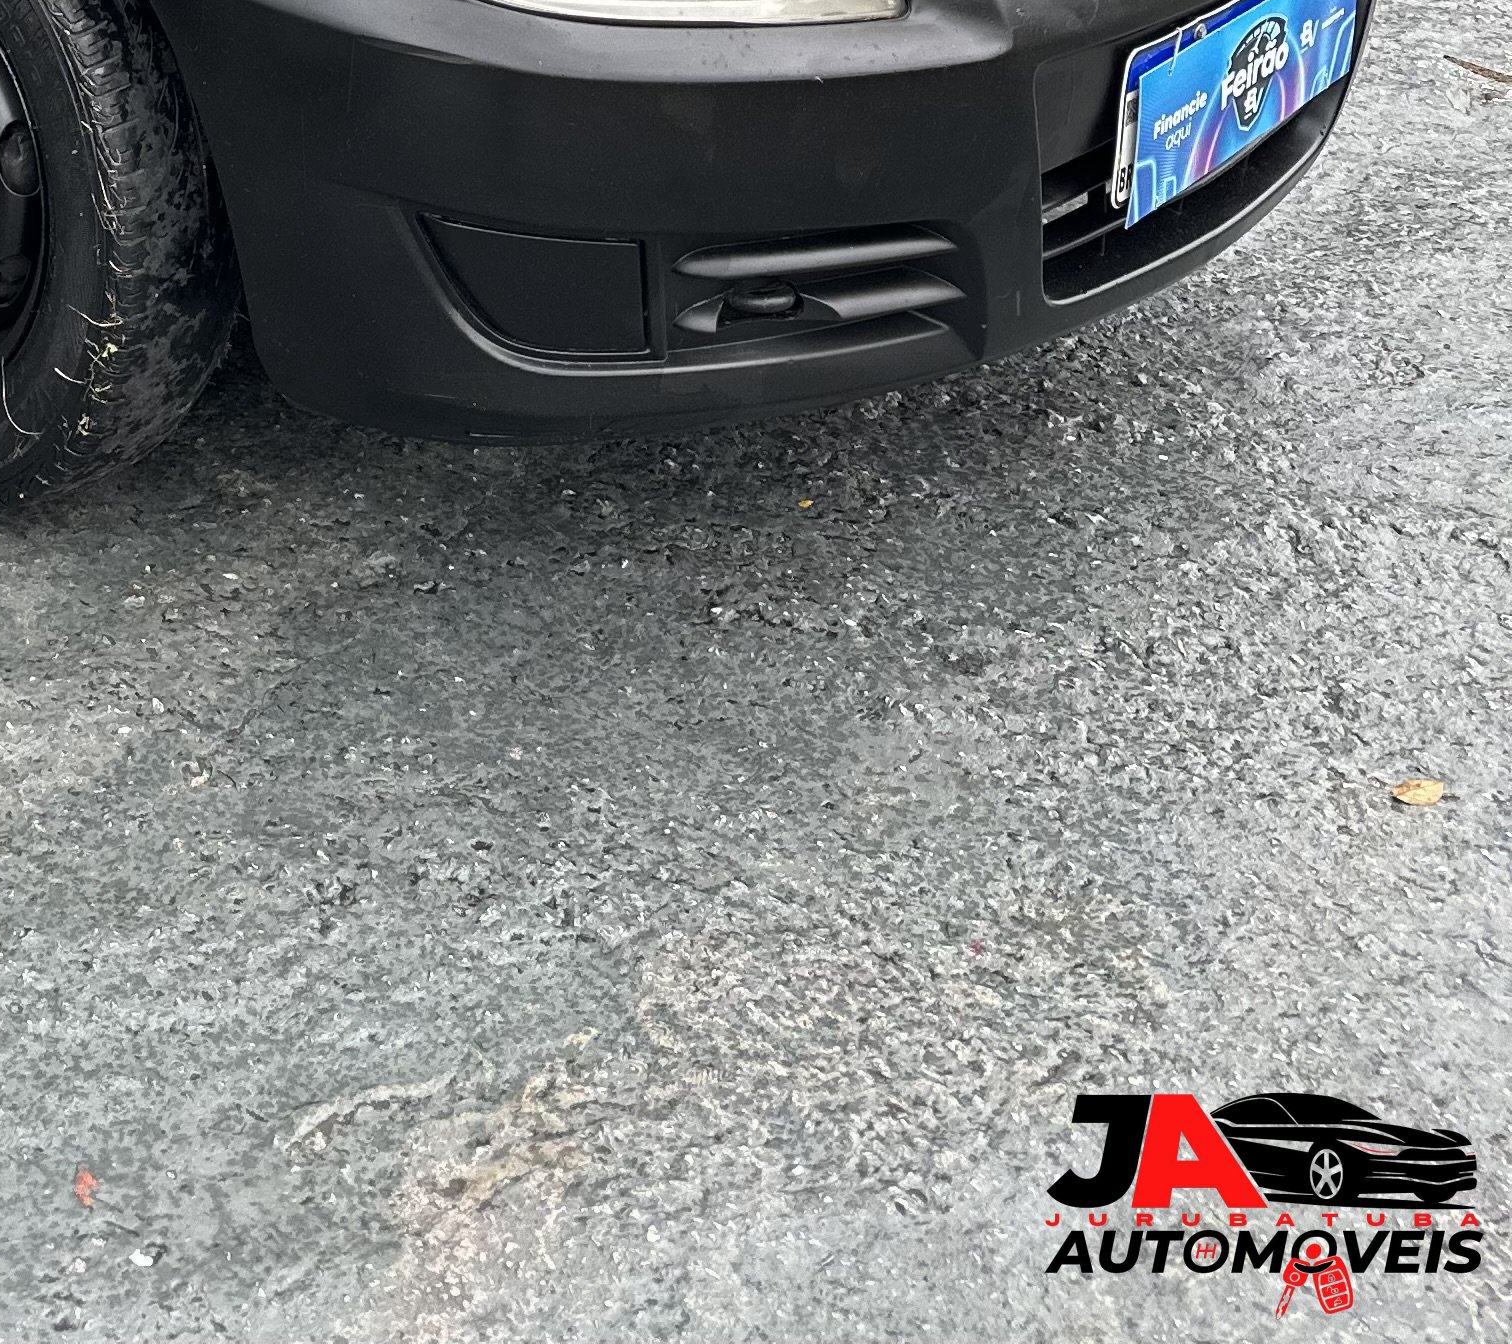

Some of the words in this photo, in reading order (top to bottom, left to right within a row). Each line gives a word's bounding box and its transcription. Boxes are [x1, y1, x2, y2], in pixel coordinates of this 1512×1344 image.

[1221, 38, 1290, 111] Feirão
[1153, 90, 1209, 141] Financie
[1165, 116, 1192, 151] aqui
